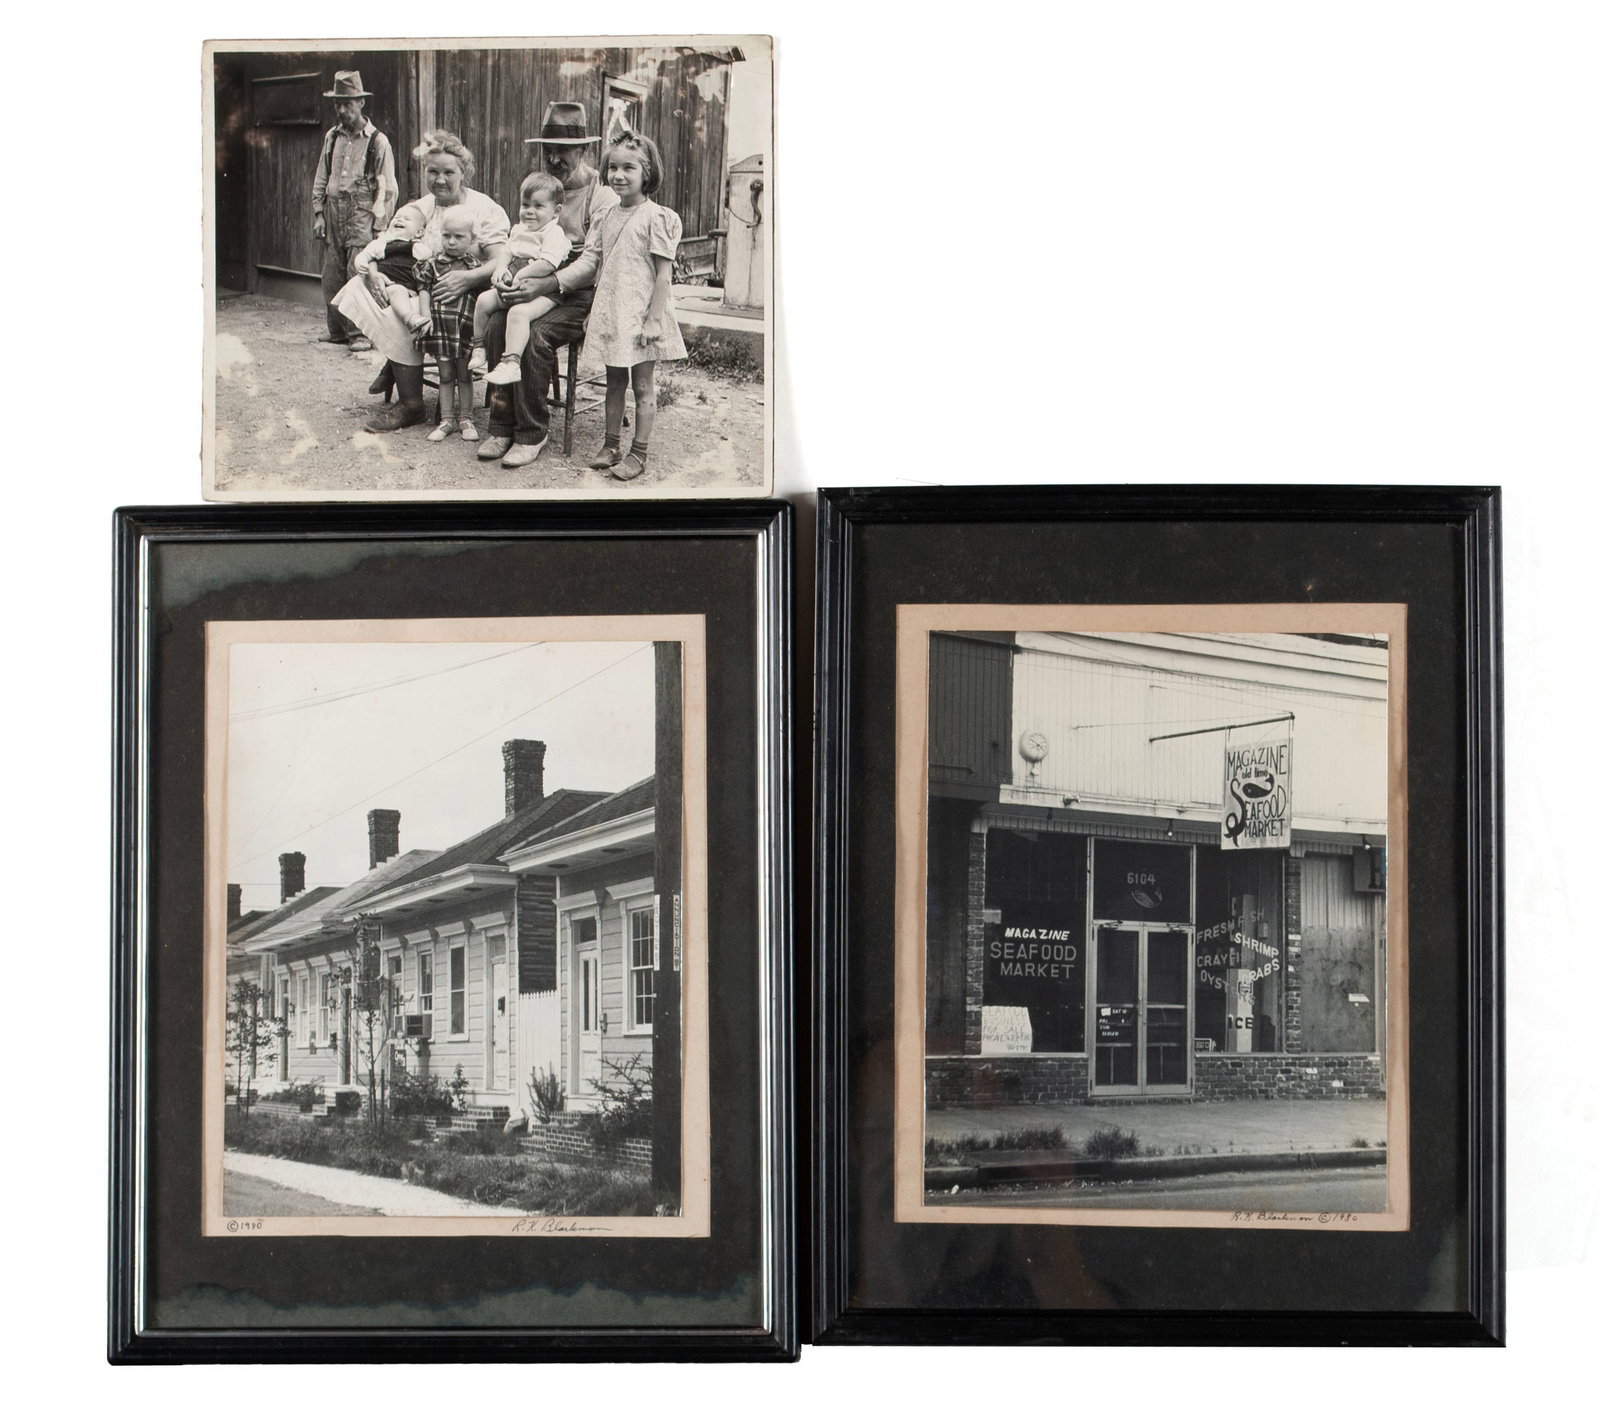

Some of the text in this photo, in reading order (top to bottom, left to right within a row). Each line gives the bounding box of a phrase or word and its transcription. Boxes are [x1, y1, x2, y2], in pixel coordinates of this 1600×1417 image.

[1227, 745, 1287, 781] MAGAZINE
[1242, 768, 1252, 779] old
[1224, 778, 1287, 847] SEAFOOD
[1244, 819, 1285, 838] MARKET
[1127, 872, 1156, 885] 6104
[1005, 927, 1070, 941] MAGAZINE
[1196, 907, 1265, 945] FRESH FSH
[990, 941, 1077, 961] SEAFOOD
[1233, 932, 1279, 959] SHRIMP
[1197, 950, 1255, 967] CRAYFI
[1000, 962, 1075, 979] MARKET
[1241, 958, 1280, 987] CRABS
[1228, 1014, 1254, 1029] ICE
